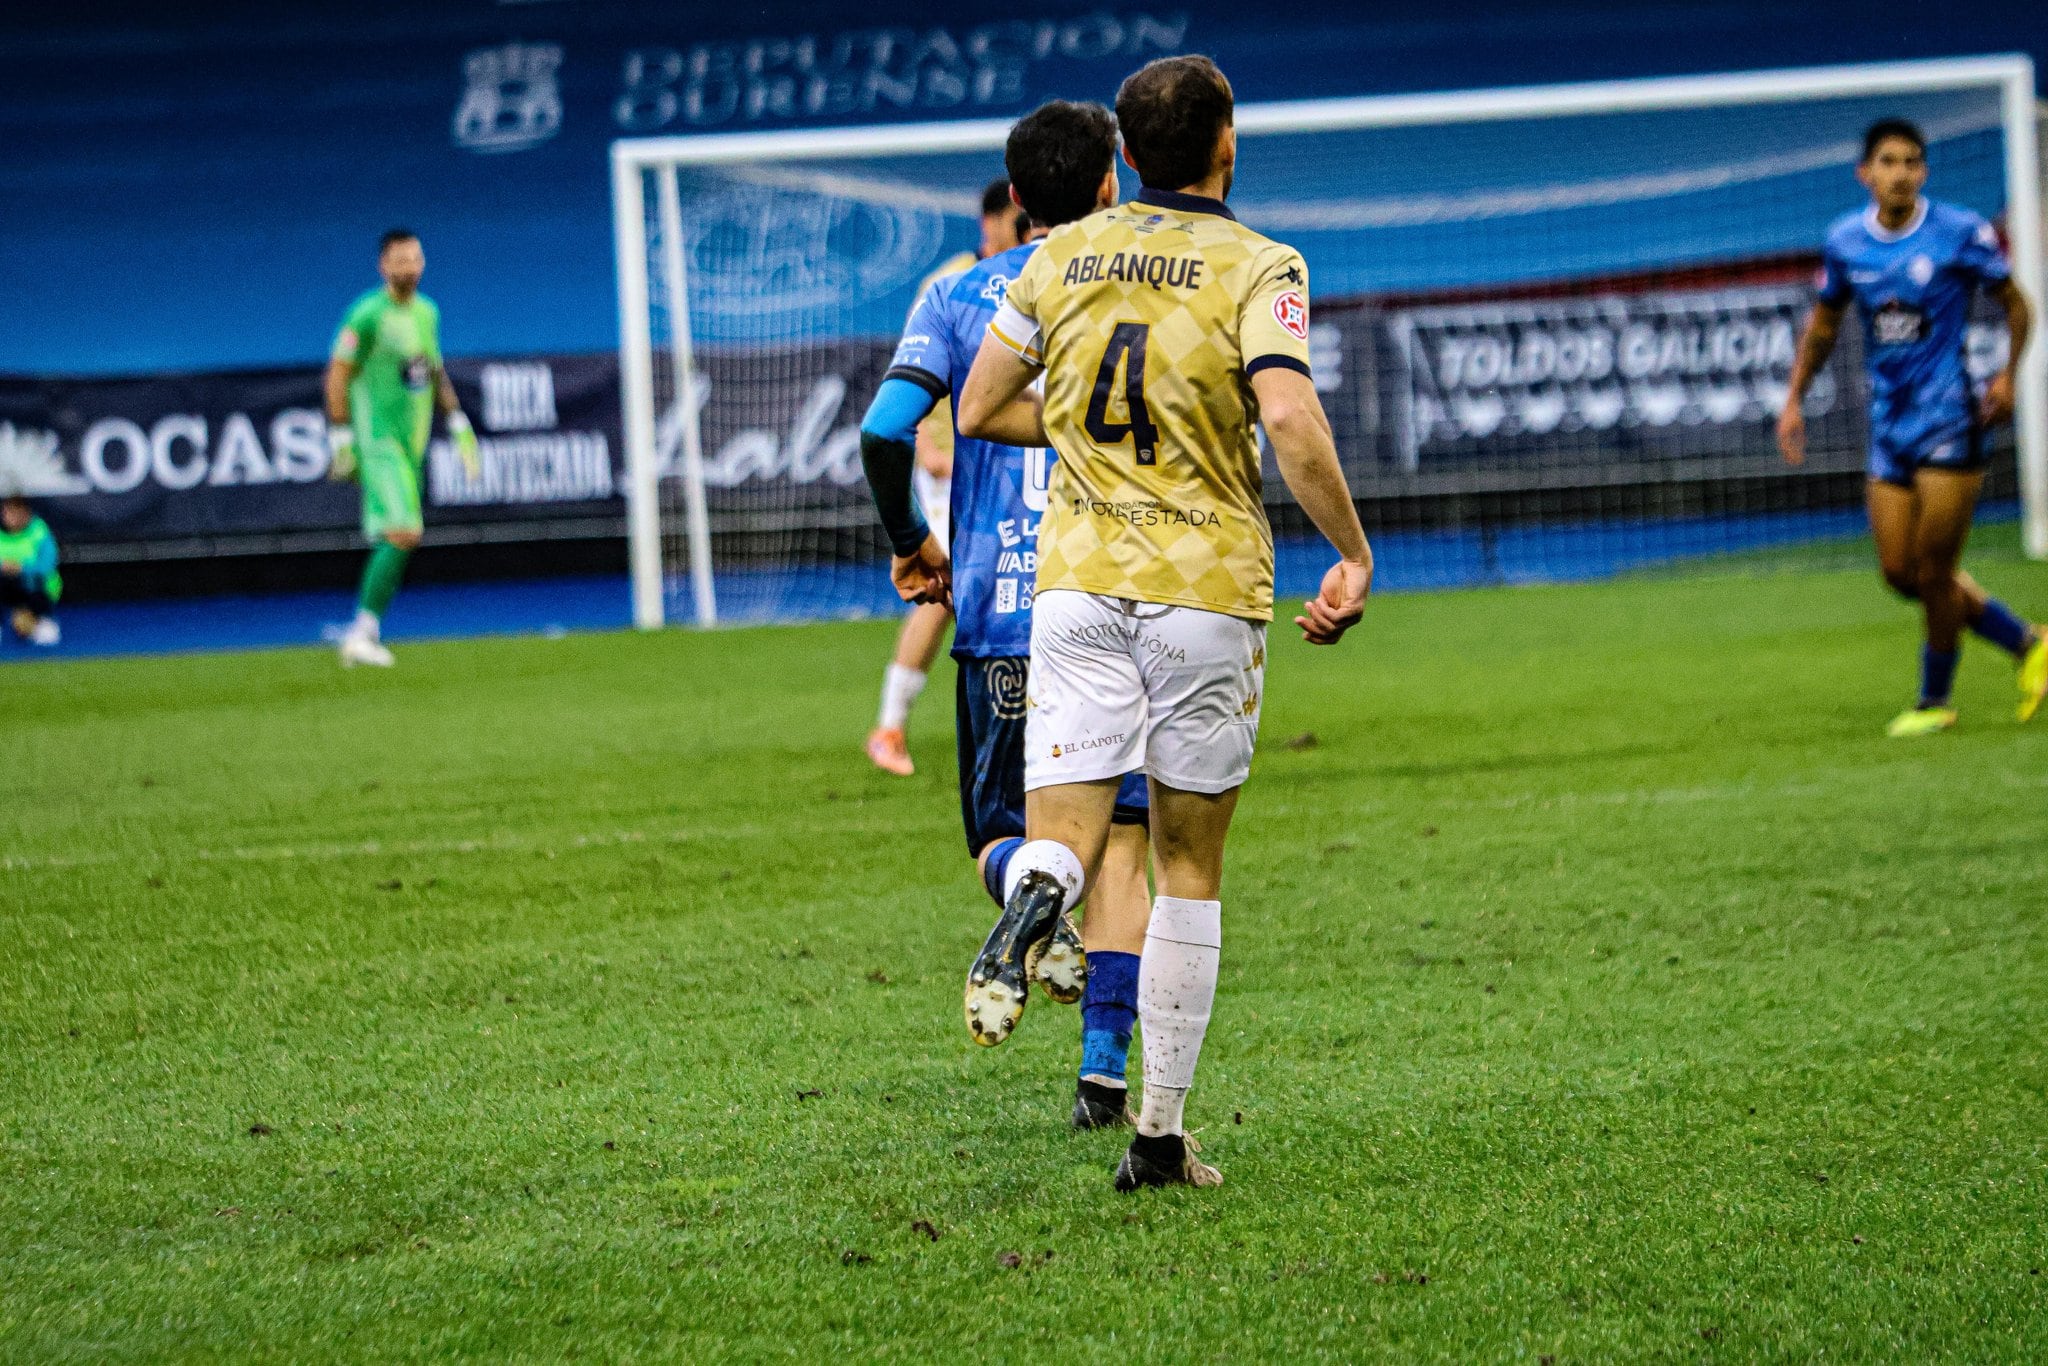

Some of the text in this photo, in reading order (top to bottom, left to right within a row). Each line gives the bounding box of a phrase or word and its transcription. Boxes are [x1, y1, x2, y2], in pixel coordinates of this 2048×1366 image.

[612, 58, 1024, 127] OURENSE
[1063, 252, 1204, 290] ABLANQUE
[1439, 318, 1796, 390] TOLDOS GALICIA
[1084, 321, 1160, 466] 4
[80, 408, 332, 493] OCAS
[1064, 733, 1126, 754] EL CAPOTE
